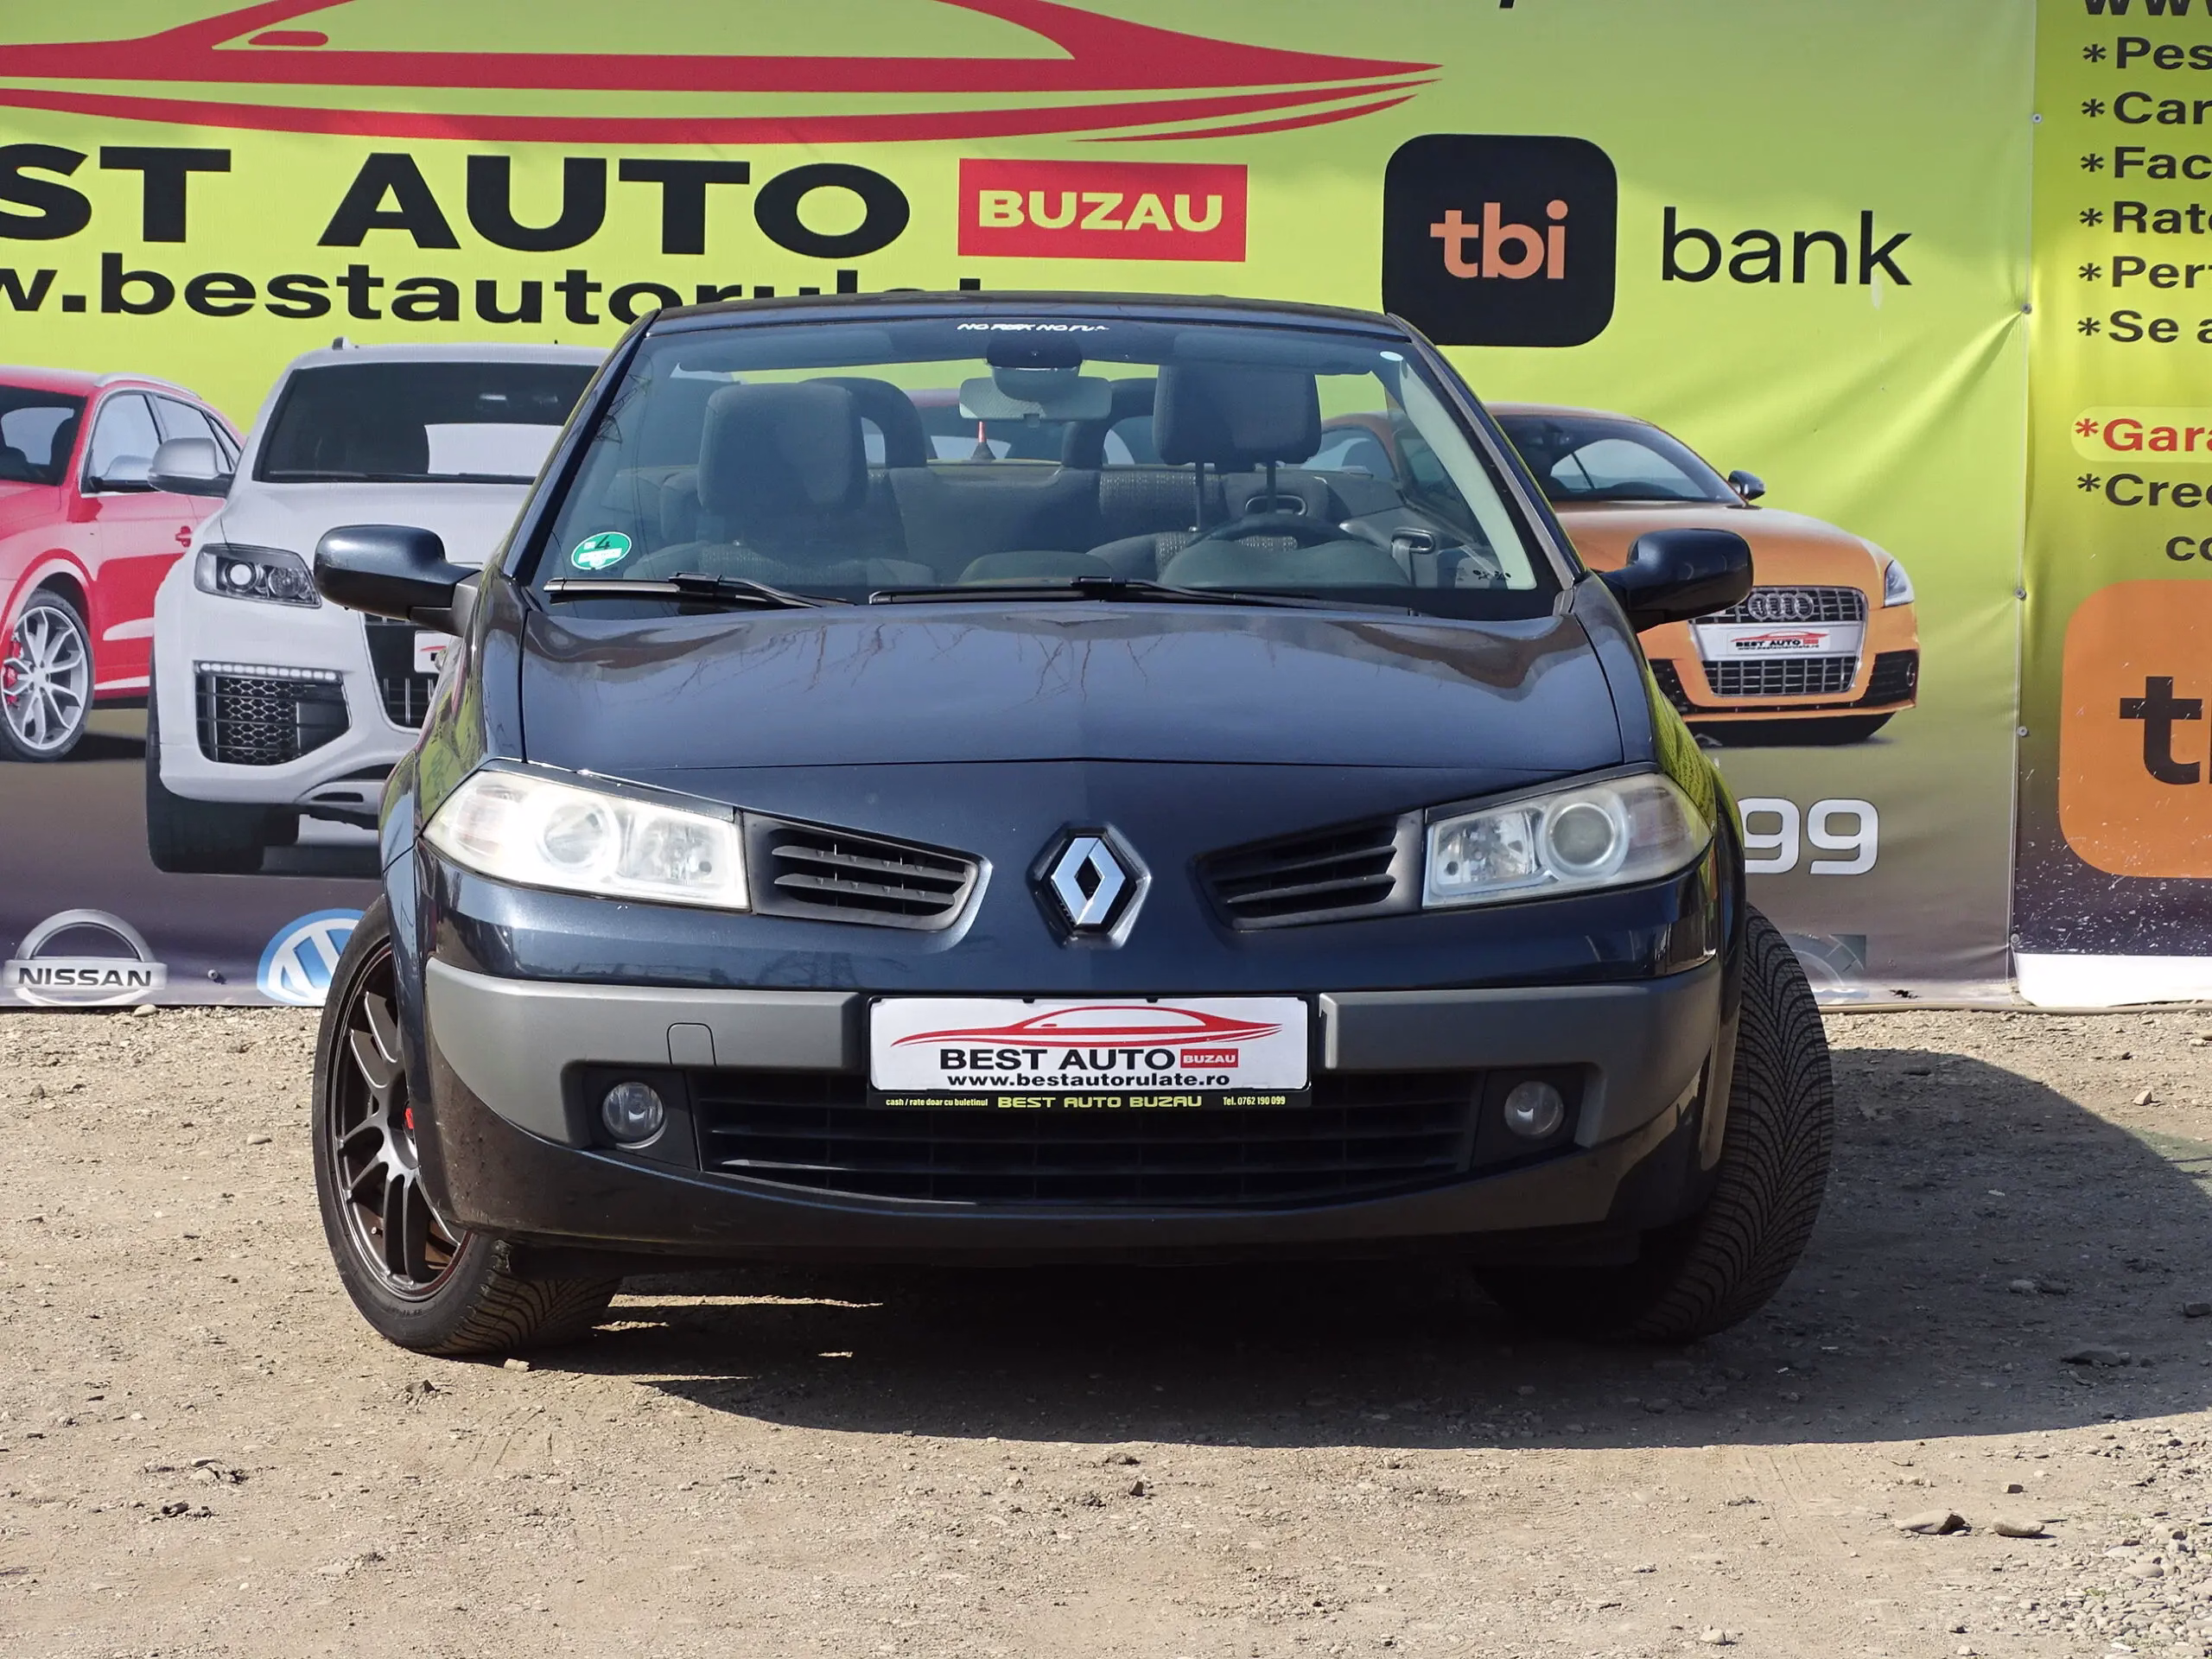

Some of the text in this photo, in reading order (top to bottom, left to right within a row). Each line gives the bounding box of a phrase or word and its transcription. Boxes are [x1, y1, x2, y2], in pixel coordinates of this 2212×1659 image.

[0, 143, 910, 259] ST AUTO
[979, 190, 1223, 233] BUZAU
[2079, 200, 2212, 234] Rat
[1430, 200, 1568, 280] tbi
[1663, 206, 1912, 286] bank
[2078, 256, 2212, 289] Per
[2075, 418, 2212, 452] Gar
[2076, 473, 2212, 508] Cre
[18, 967, 151, 987] NISSAN
[940, 1048, 1175, 1071] BEST AUTO
[1183, 1054, 1236, 1064] BUZAU
[947, 1073, 1230, 1086] www.bestautorulate.ro
[954, 1097, 988, 1106] buletinul
[998, 1096, 1202, 1108] BEST AUTO BUZAU
[1224, 1096, 1285, 1105] Tel. 0762 190 099
